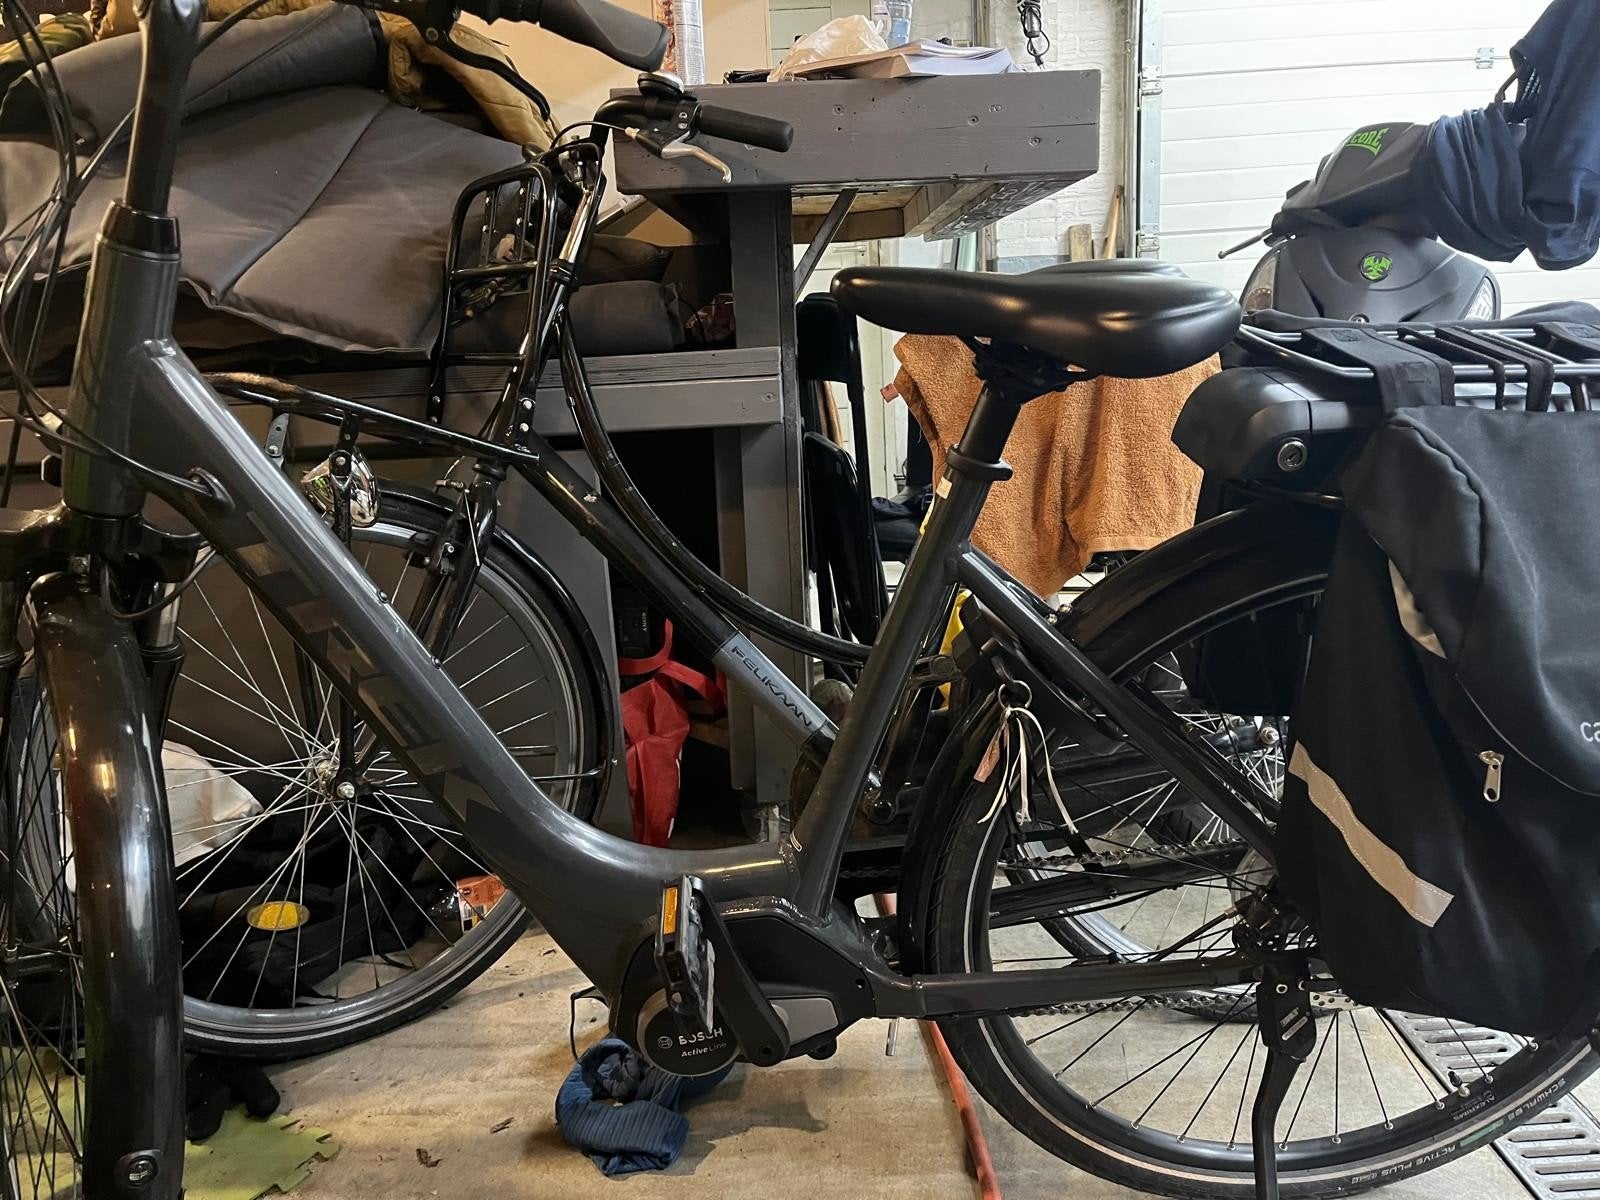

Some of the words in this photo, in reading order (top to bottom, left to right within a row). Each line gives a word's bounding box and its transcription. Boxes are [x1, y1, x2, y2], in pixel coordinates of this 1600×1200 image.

[1507, 1078, 1566, 1120] SCHWALBE
[1415, 1144, 1456, 1166] ACTIVE
[1381, 1161, 1412, 1176] PLUS
